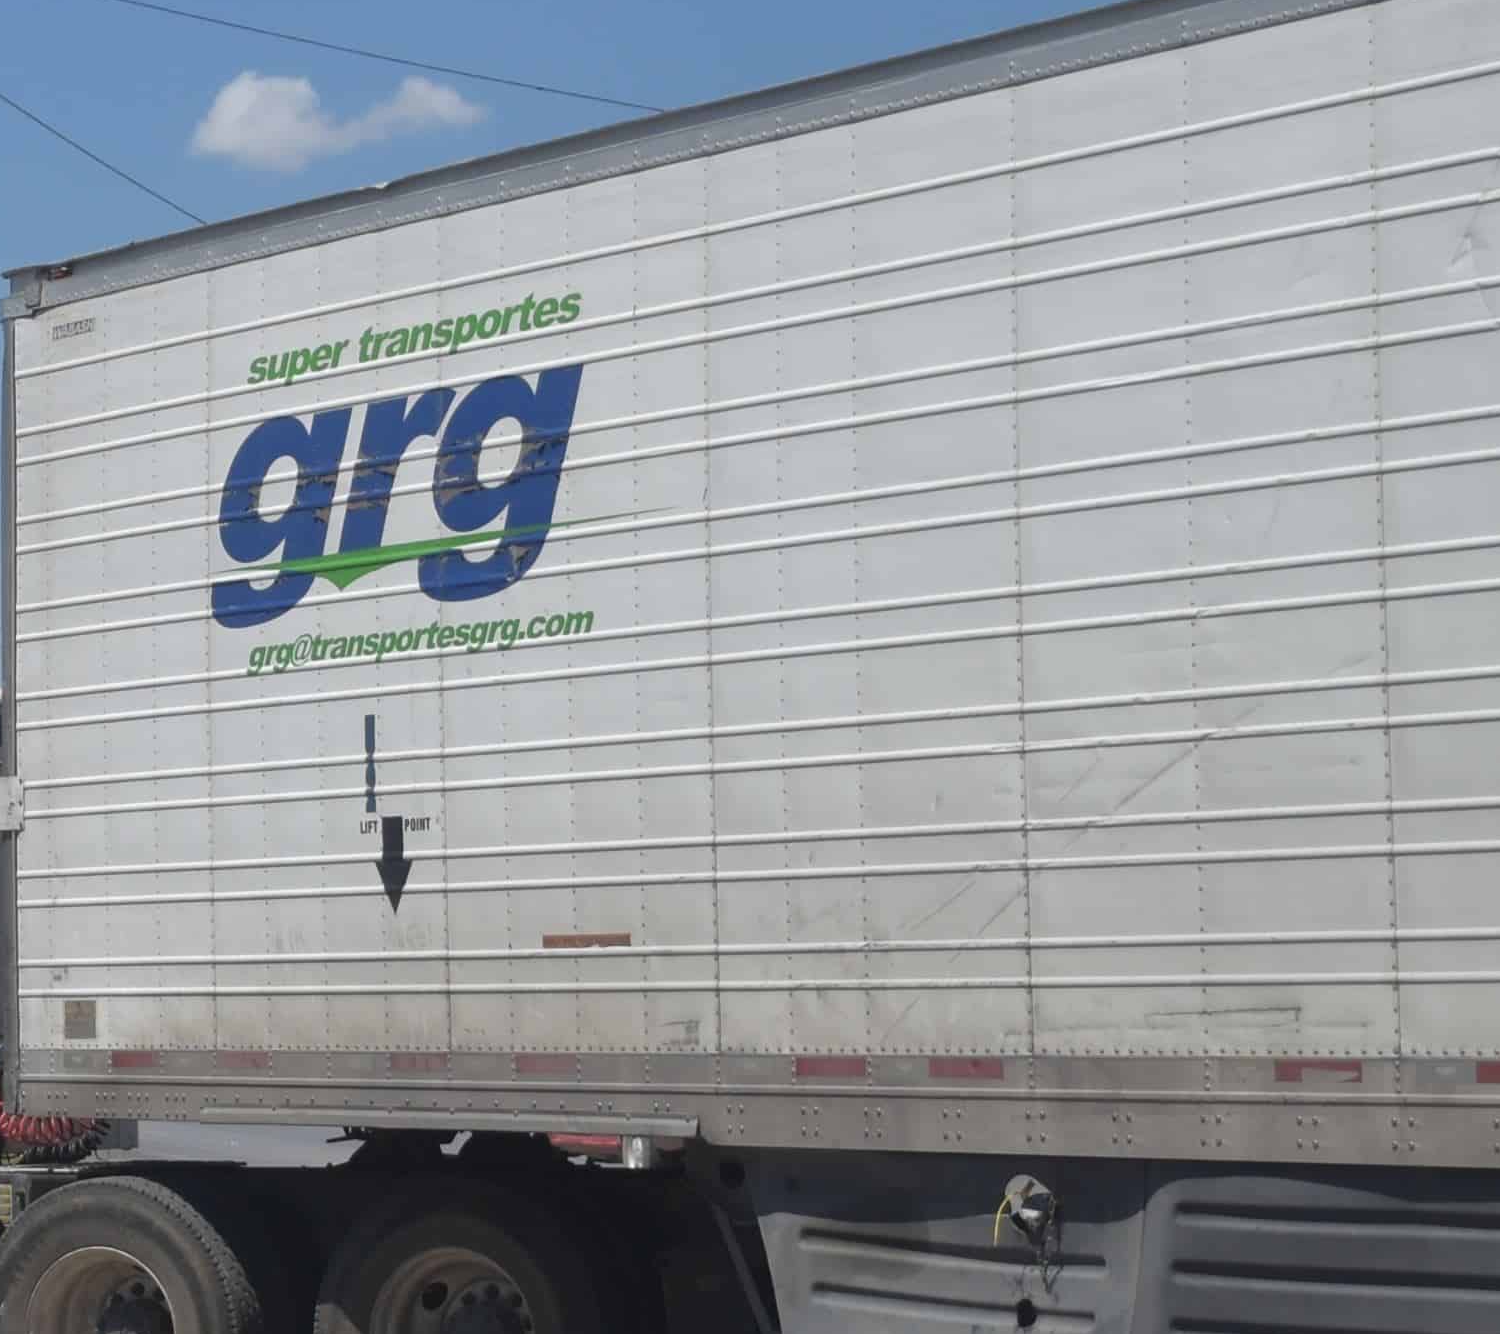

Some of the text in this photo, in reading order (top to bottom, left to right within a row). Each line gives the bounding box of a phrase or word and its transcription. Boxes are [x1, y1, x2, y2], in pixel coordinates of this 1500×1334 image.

[247, 291, 582, 386] super transportes
[210, 362, 585, 629] grg
[246, 610, 594, 675] grg@transportesgrg.com
[359, 817, 431, 835] LIFT POINT
